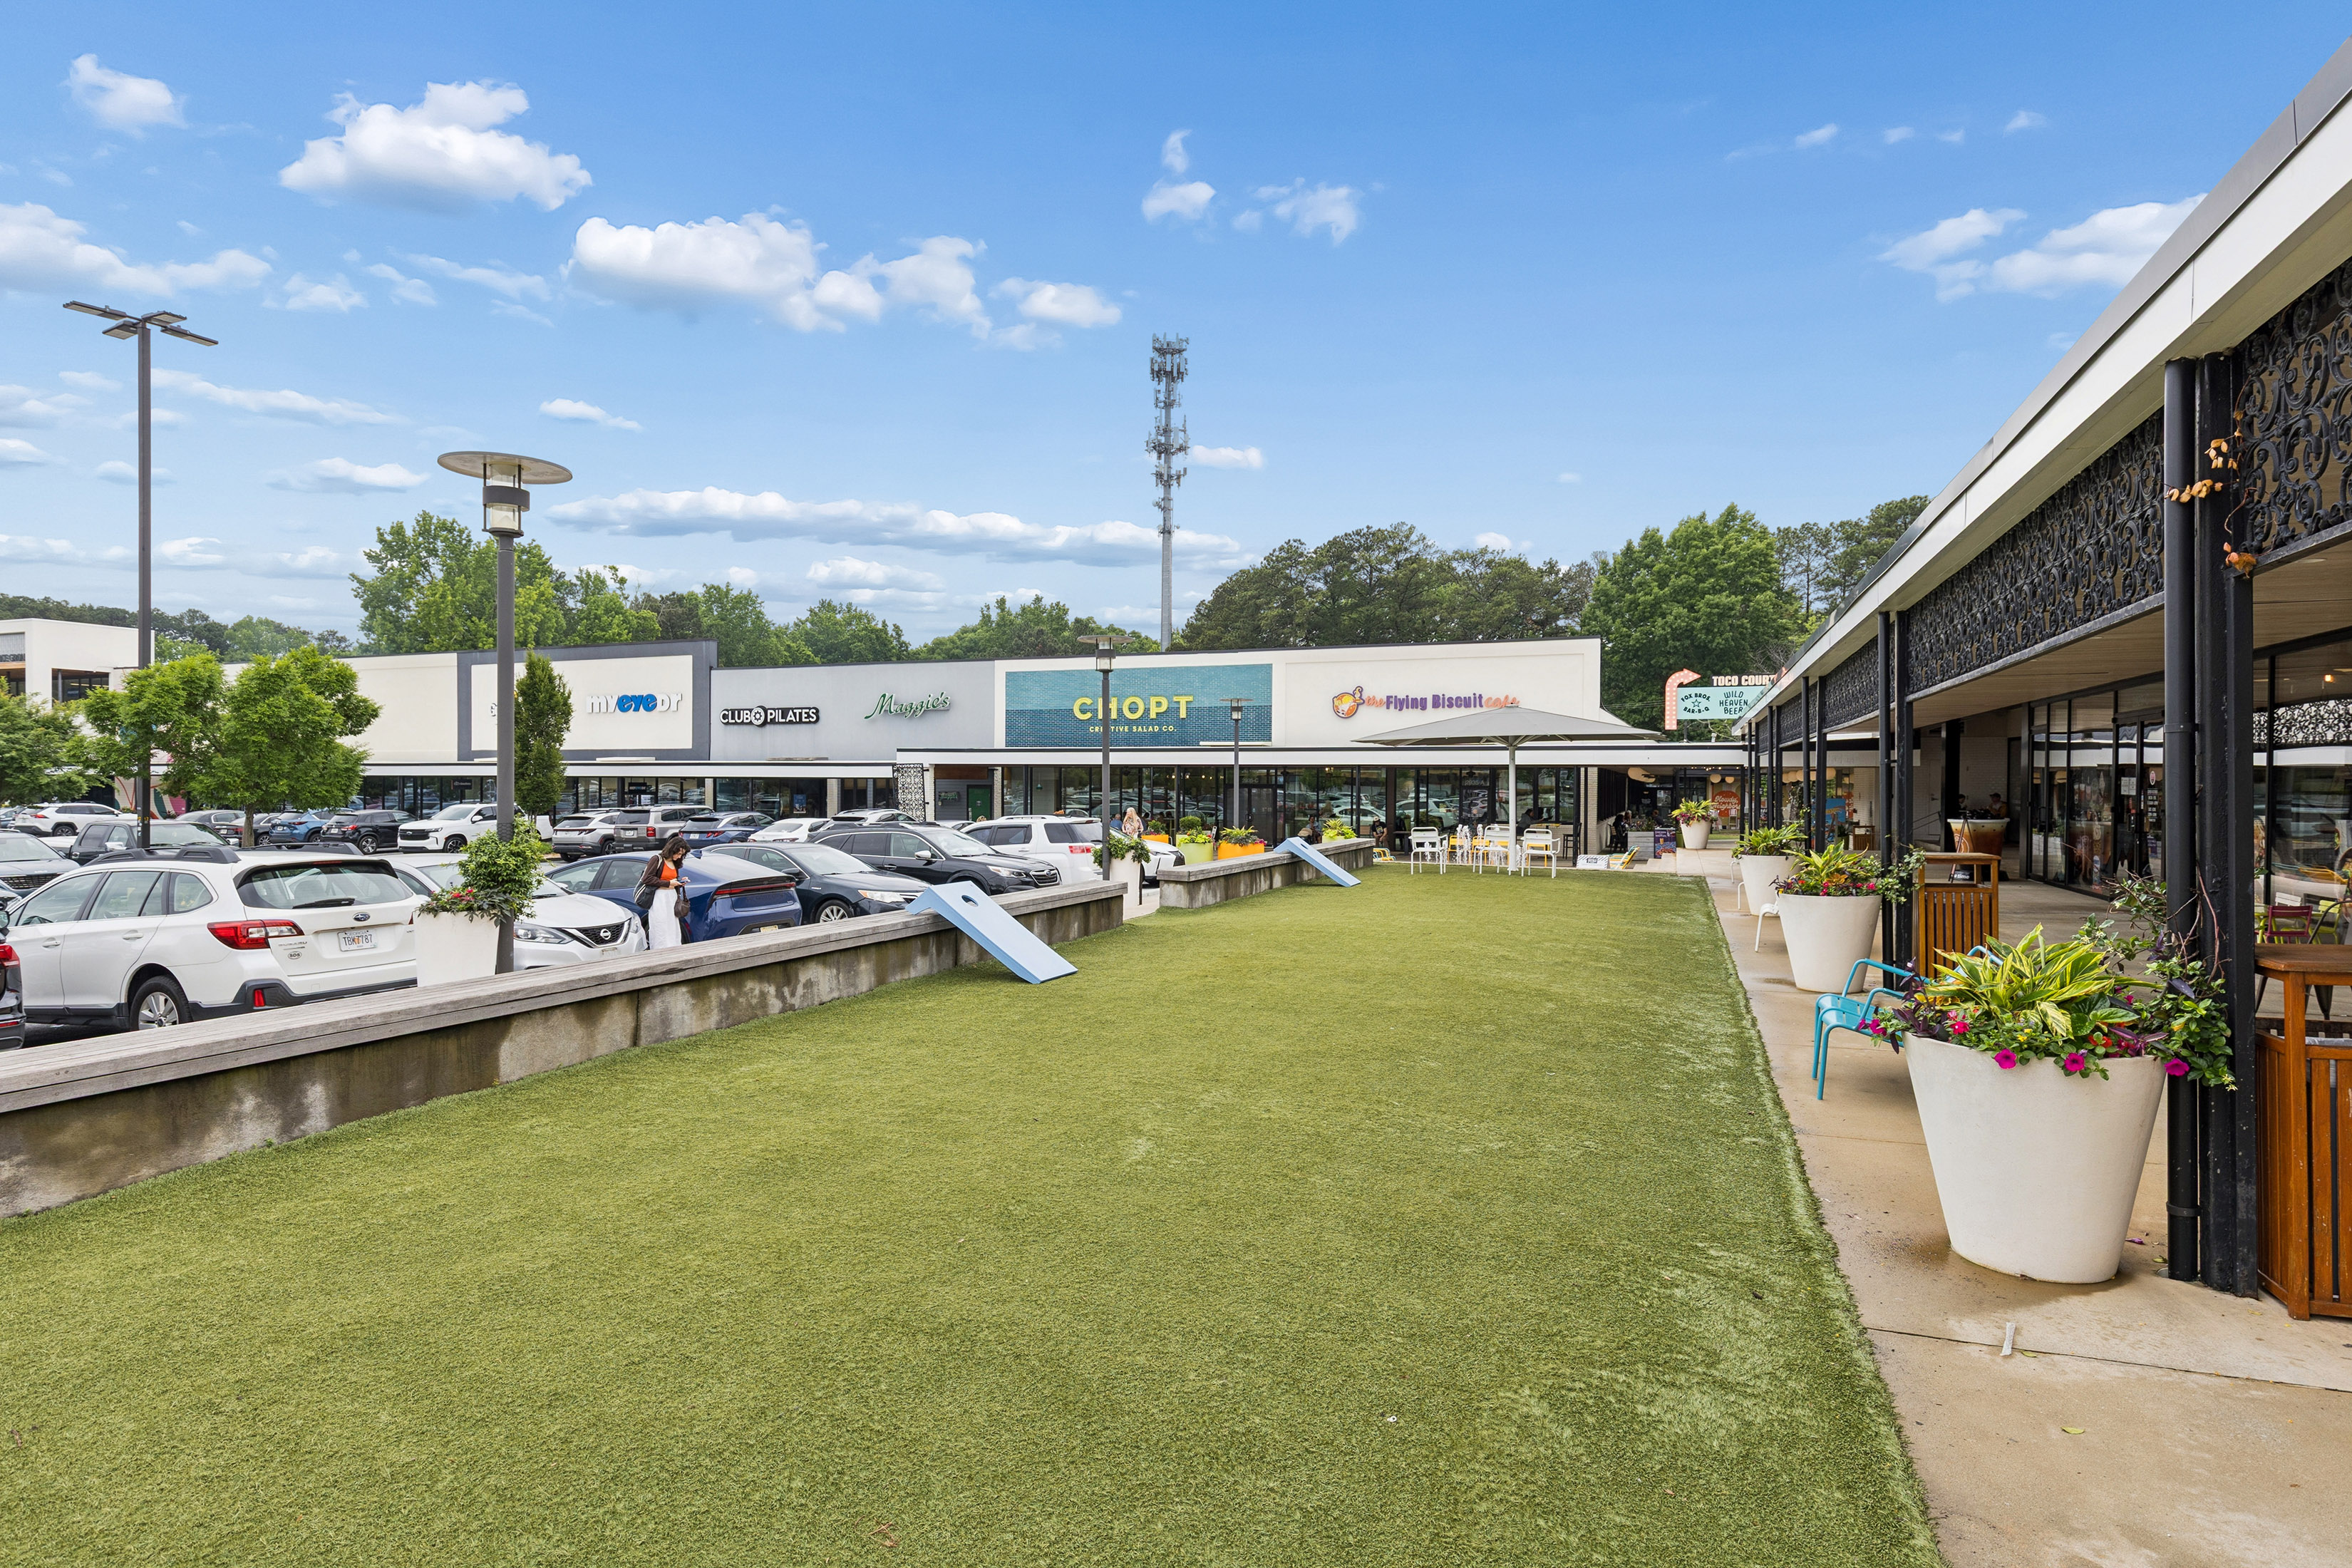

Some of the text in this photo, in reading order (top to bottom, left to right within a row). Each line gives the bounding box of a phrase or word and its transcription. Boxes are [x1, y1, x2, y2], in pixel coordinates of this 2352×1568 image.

[1712, 676, 1738, 686] TOCO
[1365, 695, 1386, 708] the
[1386, 694, 1428, 711] Flying
[1432, 692, 1483, 709] Biscuit
[1681, 693, 1711, 702] FOX BROS.
[864, 691, 951, 720] Maggie's
[1073, 695, 1194, 721] CHOPT
[1723, 706, 1743, 715] BEER
[720, 708, 817, 723] CLUB PILATES
[342, 934, 373, 947] TBK7787
